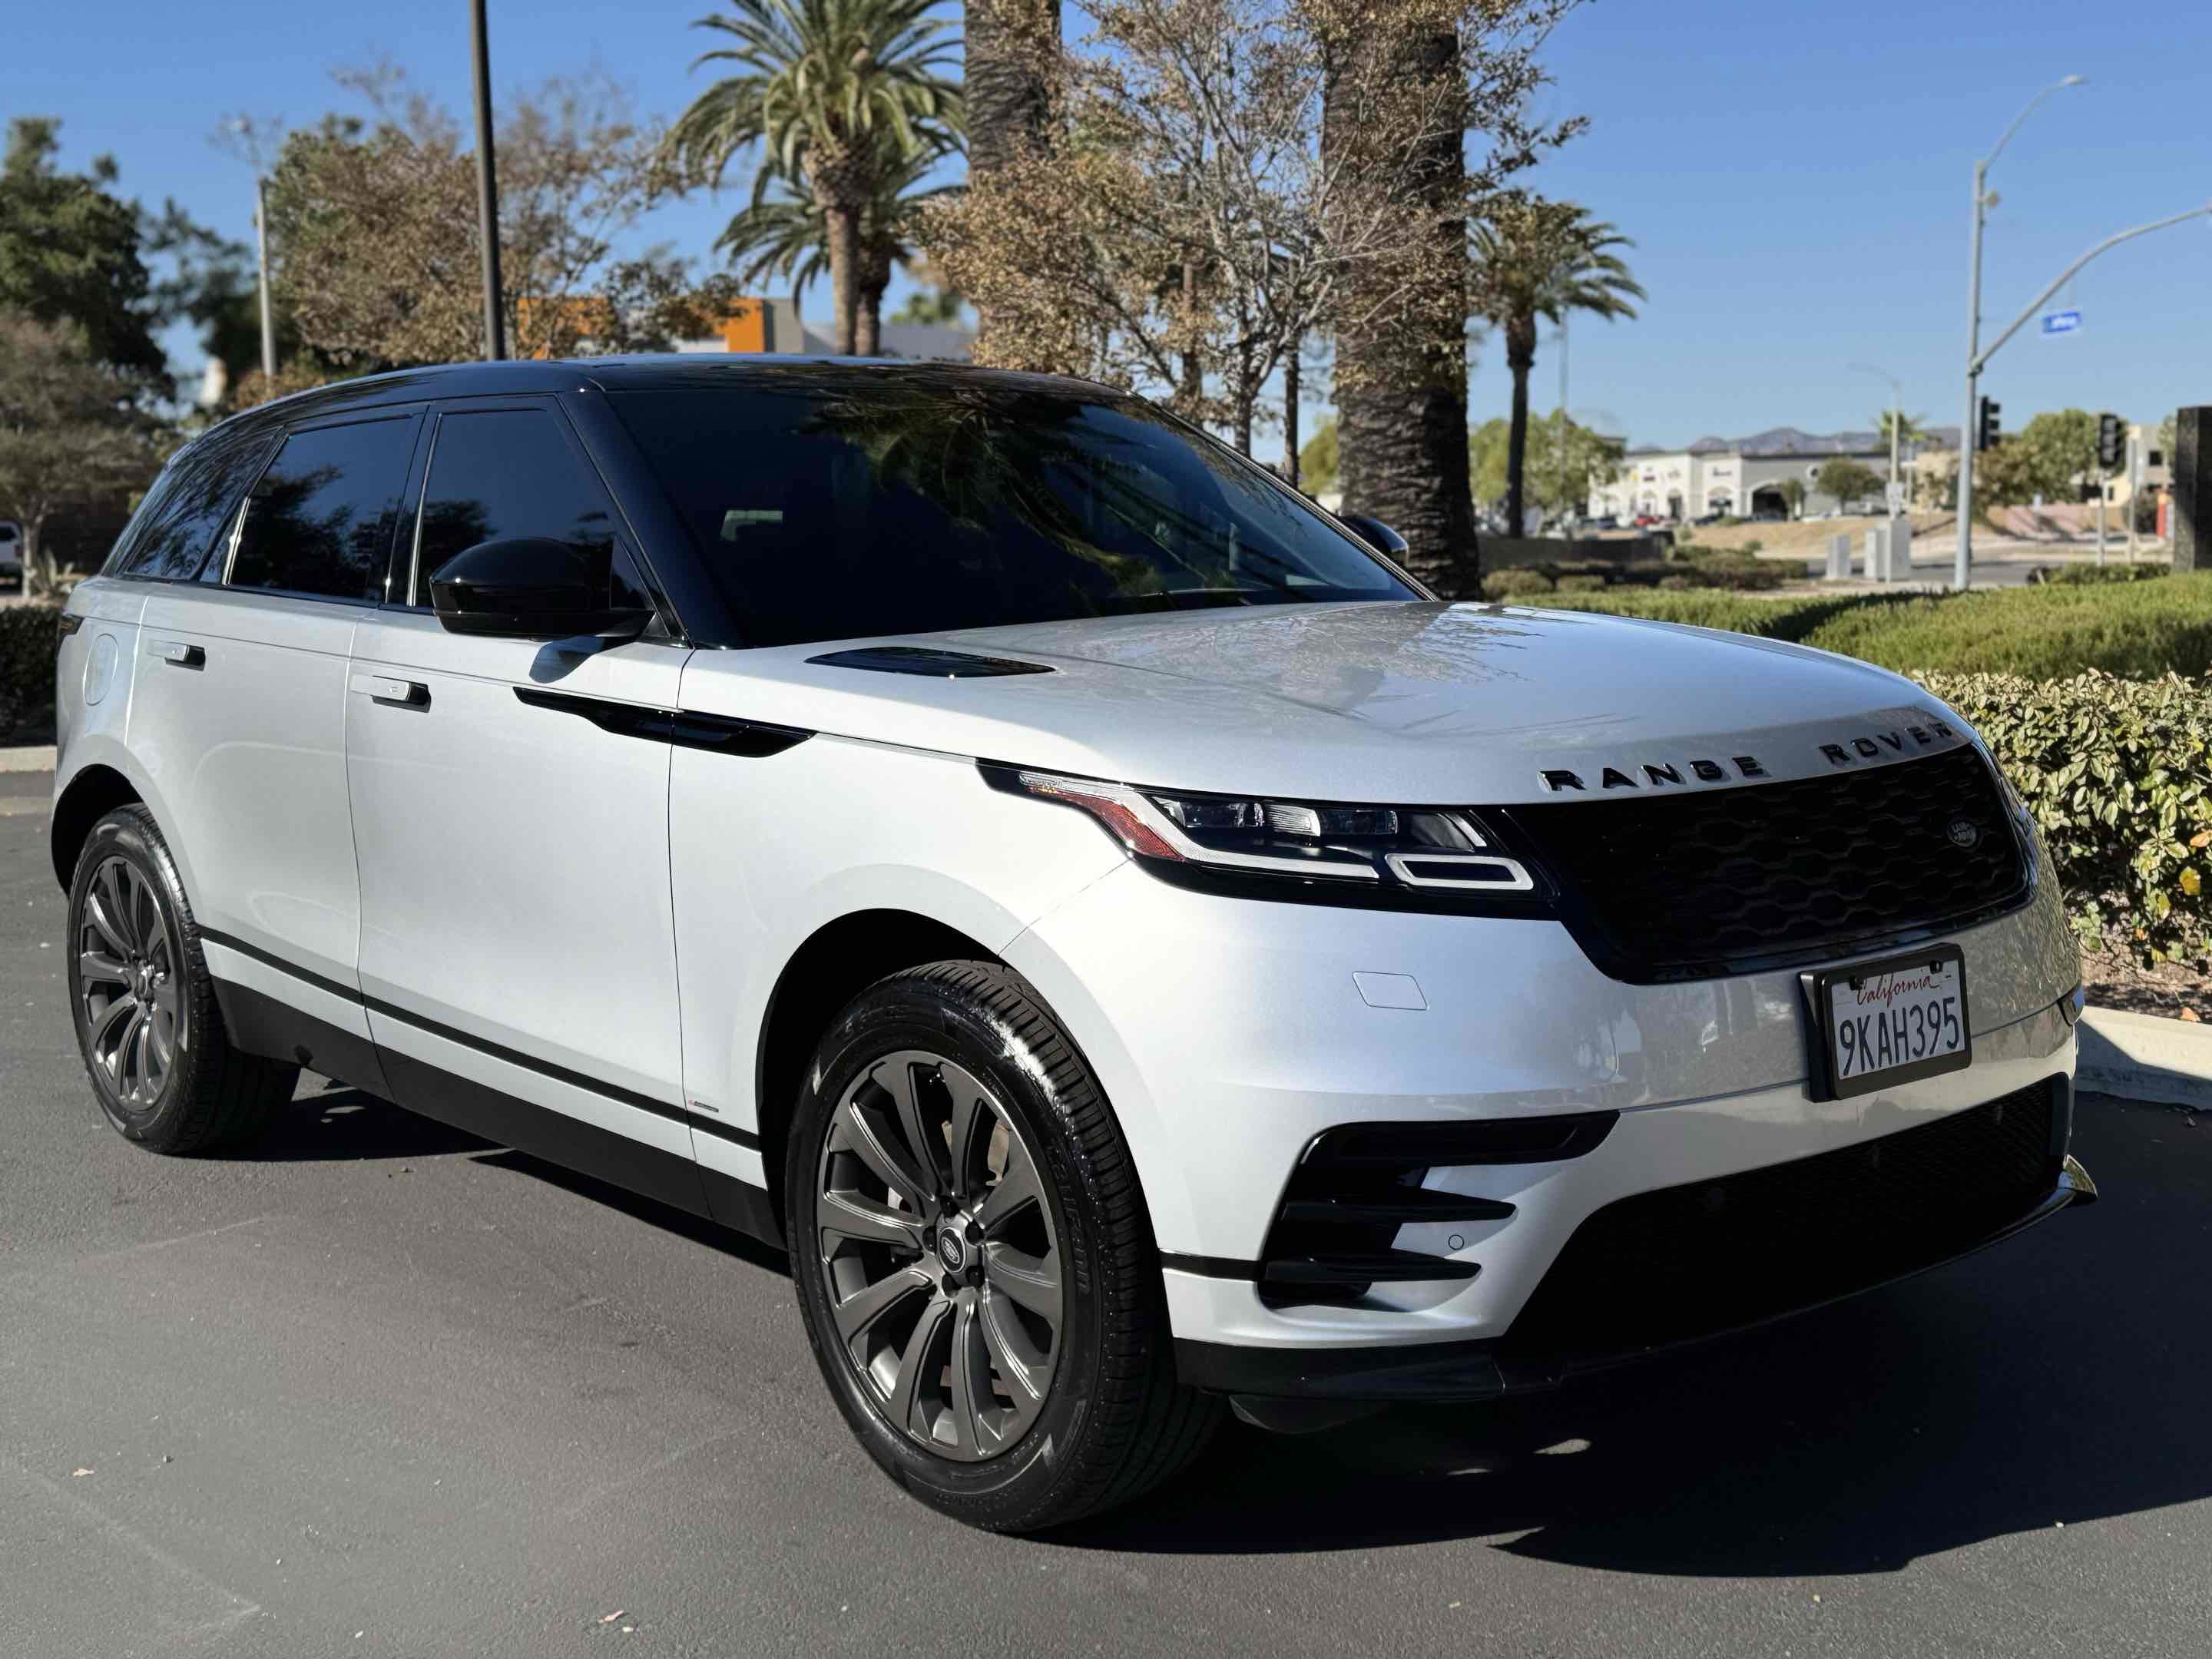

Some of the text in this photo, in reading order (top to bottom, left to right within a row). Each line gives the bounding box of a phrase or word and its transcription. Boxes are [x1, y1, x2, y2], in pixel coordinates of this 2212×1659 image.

[1540, 722, 1952, 792] RANGE ROVER
[1840, 997, 1959, 1076] 9KAH395
